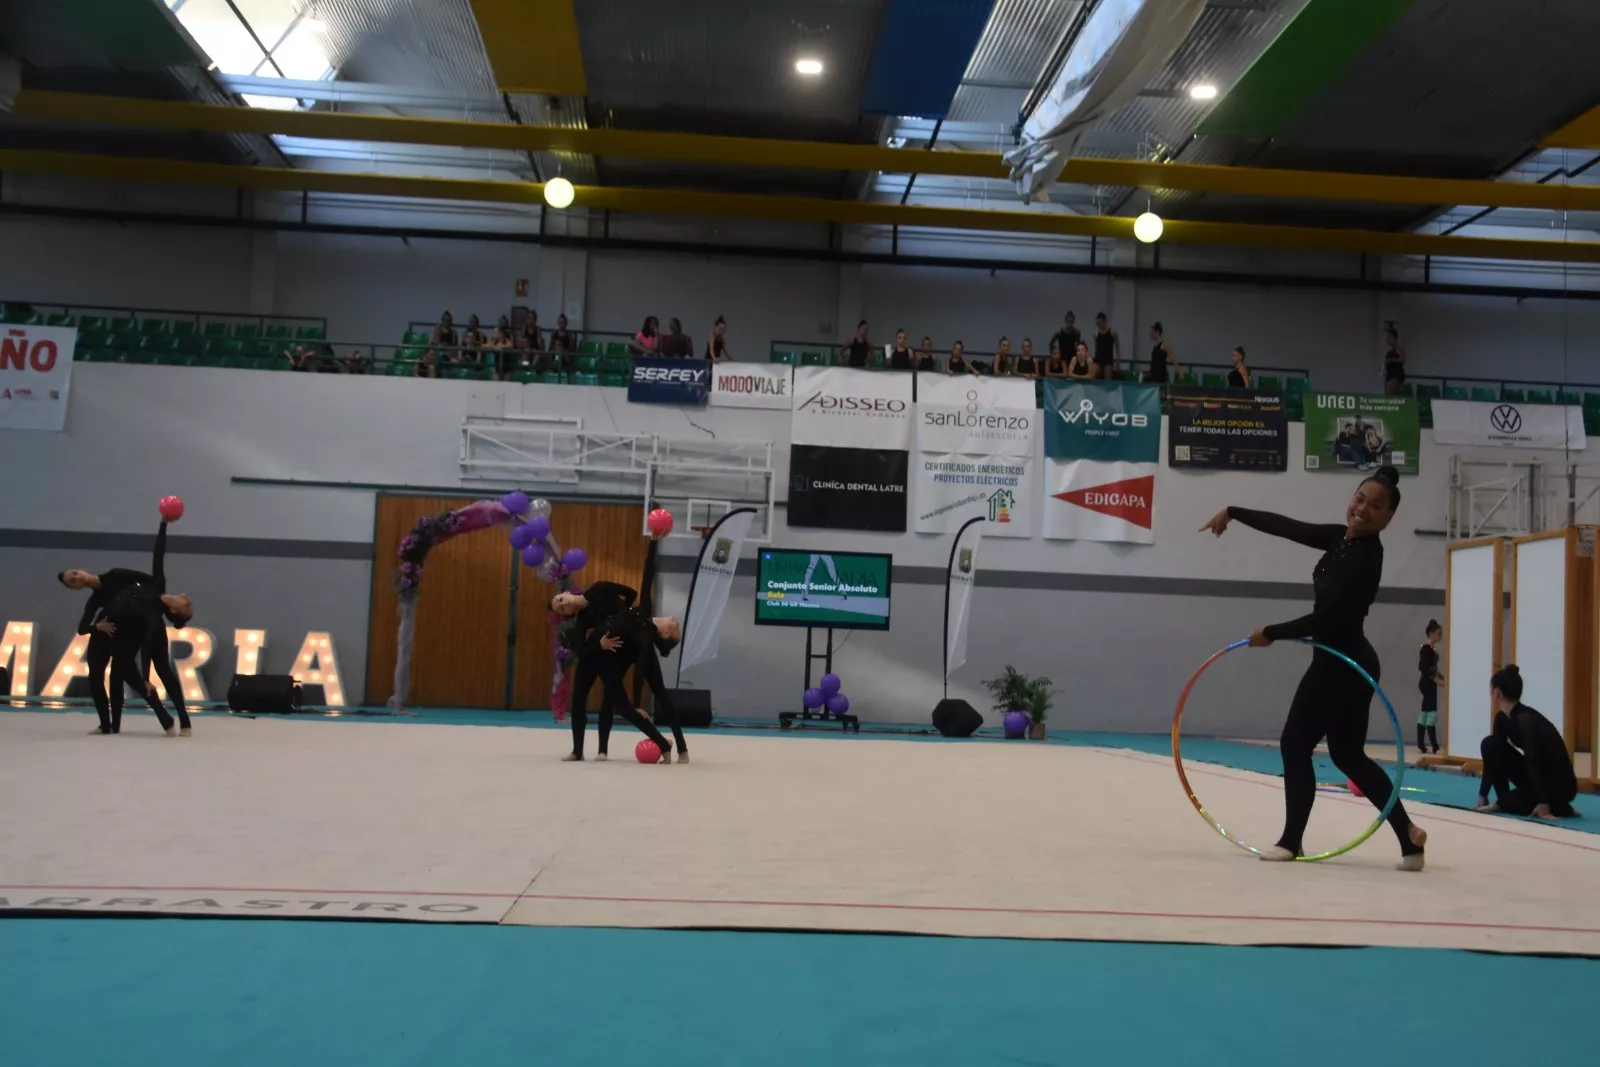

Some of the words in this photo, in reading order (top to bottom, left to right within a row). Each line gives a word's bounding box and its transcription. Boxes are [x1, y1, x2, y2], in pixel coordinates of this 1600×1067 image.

[633, 367, 704, 382] SERFEY
[718, 375, 786, 396] MODOVIAJE
[797, 391, 906, 412] ADISSEO
[1317, 394, 1356, 410] UNED
[924, 411, 1029, 430] sanLorenzo
[1058, 399, 1147, 427] WIYOB
[1242, 429, 1278, 437] OPCIONES
[924, 461, 976, 473] CERTIFICADOS
[934, 474, 975, 484] PROYECTOS
[847, 483, 878, 491] DENTAL
[879, 484, 904, 493] LATRE
[1084, 492, 1146, 508] EDIGAPA
[767, 580, 807, 591] Conjunto
[809, 582, 837, 592] Senior
[838, 584, 878, 593] Absoluto
[767, 591, 785, 599] Gala
